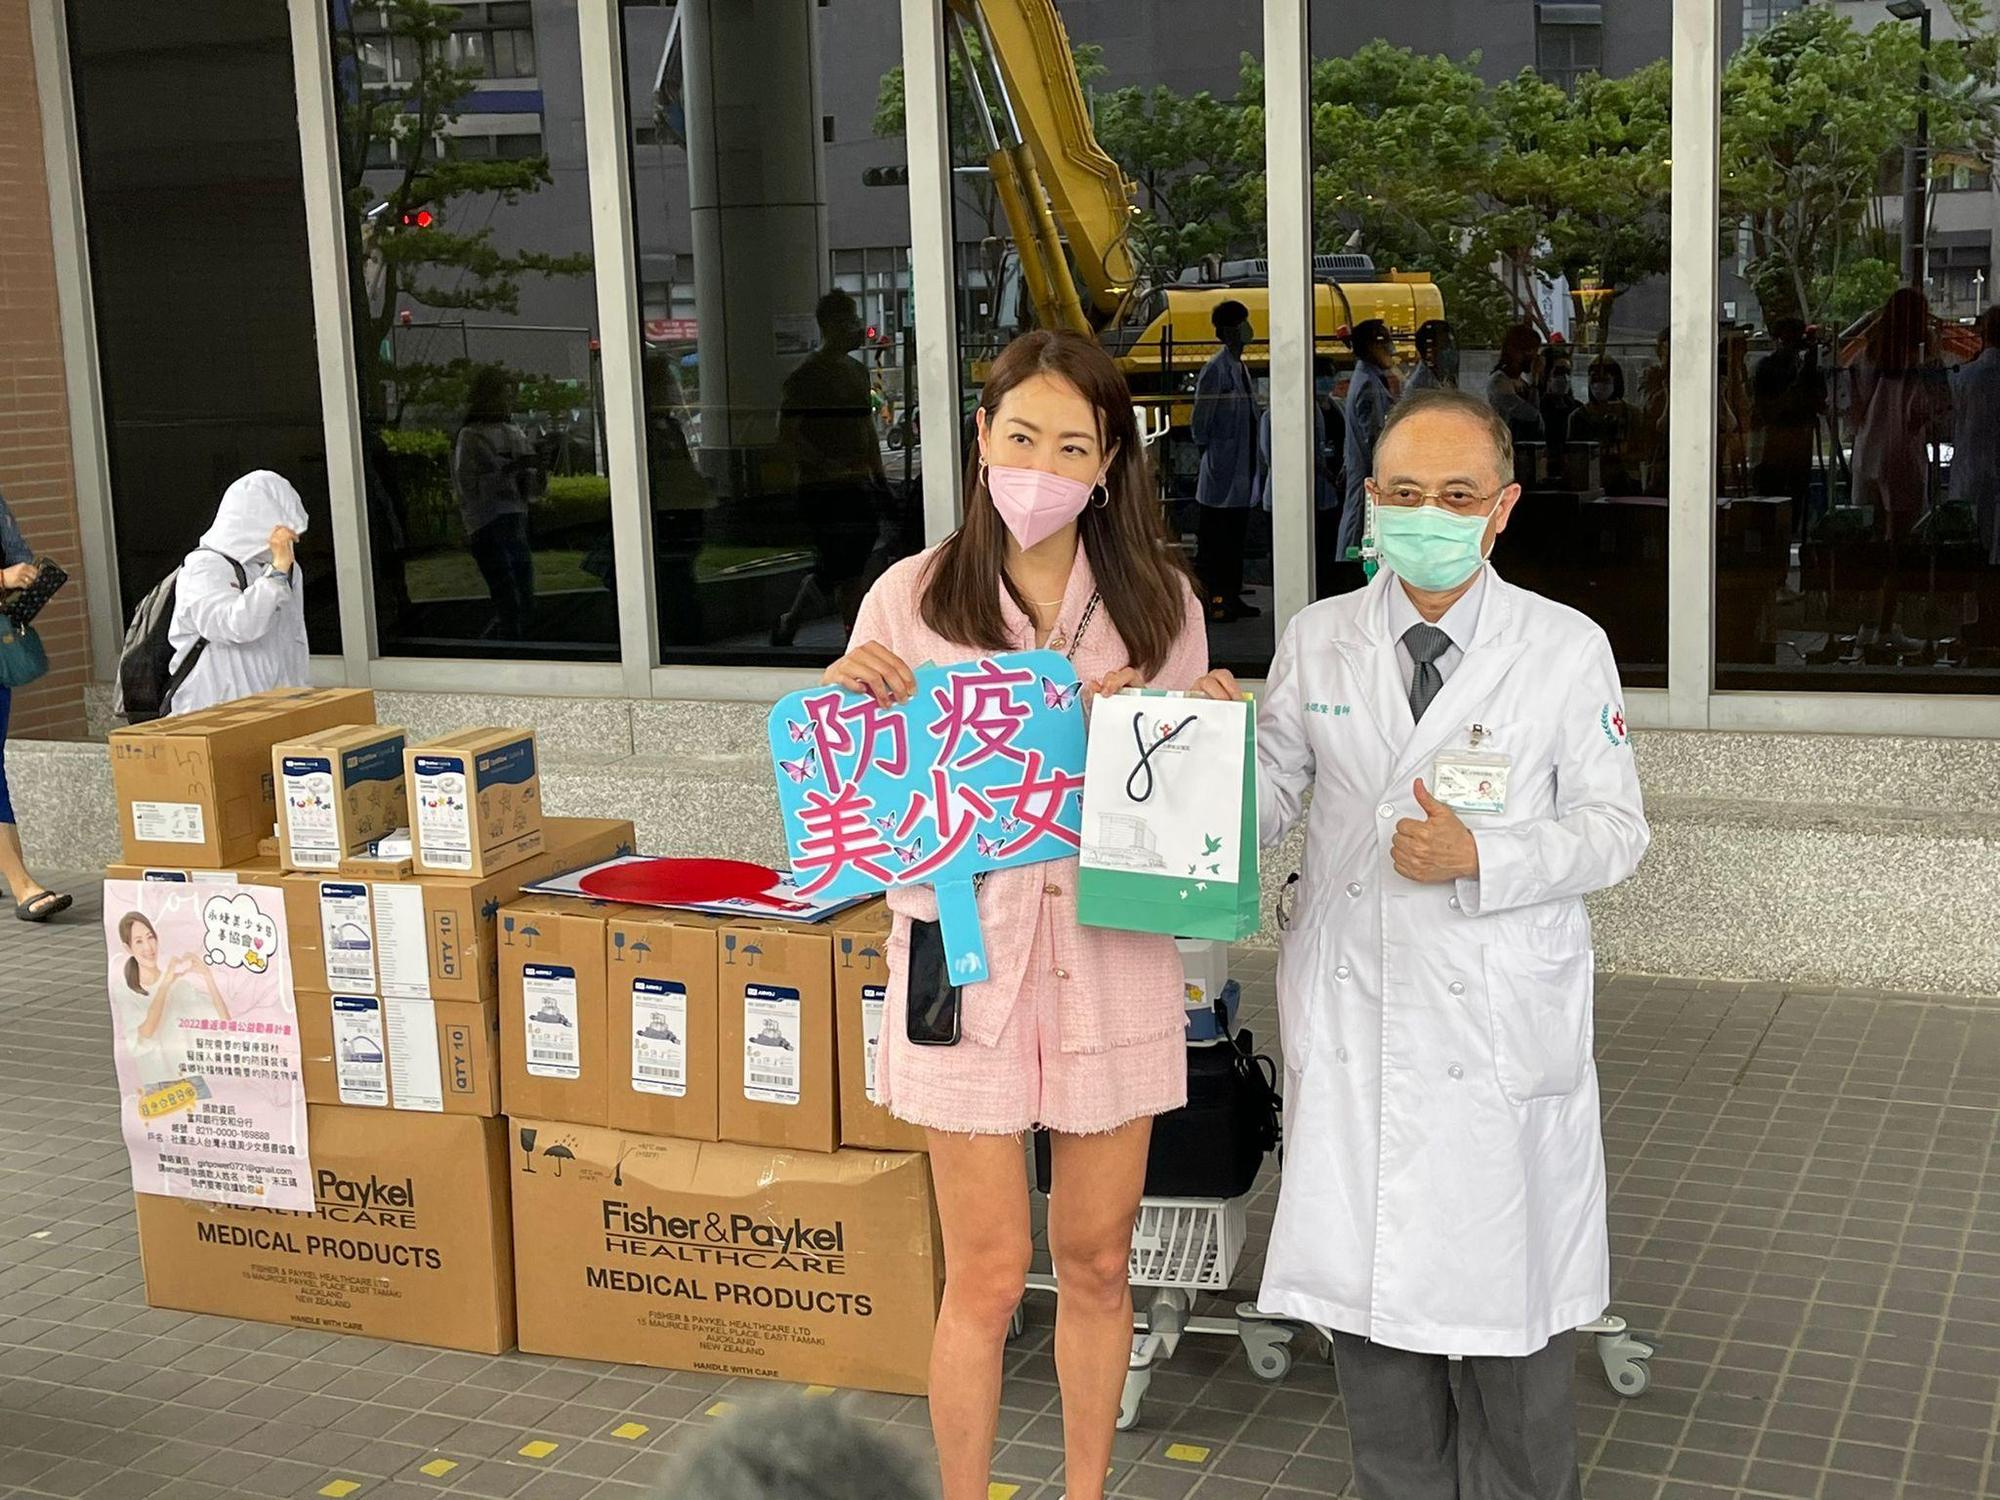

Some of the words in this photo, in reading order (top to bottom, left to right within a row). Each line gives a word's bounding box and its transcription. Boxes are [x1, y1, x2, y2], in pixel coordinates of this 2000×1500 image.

[804, 659, 1035, 795] 防疫
[793, 752, 1084, 897] 美少女
[440, 916, 452, 936] 10
[443, 941, 455, 976] QTY
[452, 1031, 464, 1051] 10
[454, 1055, 467, 1089] QTY
[317, 1169, 414, 1209] Paykel
[197, 1221, 301, 1254] MEDICAL
[306, 1235, 442, 1269] PRODUCTS
[606, 1237, 846, 1275] HEALTHCARE
[586, 1266, 707, 1300] MEDICAL
[715, 1282, 873, 1316] PRODUCTS
[649, 1310, 681, 1322] FISHER
[692, 1315, 727, 1327] PAYKEL
[729, 1320, 791, 1334] HEALTHCARE
[793, 1327, 811, 1336] LTD
[649, 1319, 690, 1331] MAURICE
[693, 1325, 727, 1335] PAYKEL
[764, 1331, 787, 1341] EAST
[700, 1341, 721, 1351] NEW
[723, 1344, 765, 1356] ZEALAND
[706, 1334, 756, 1347] AUCKLAND
[693, 1361, 729, 1373] HANDLE
[730, 1365, 753, 1375] WITH
[755, 1368, 779, 1378] CARE
